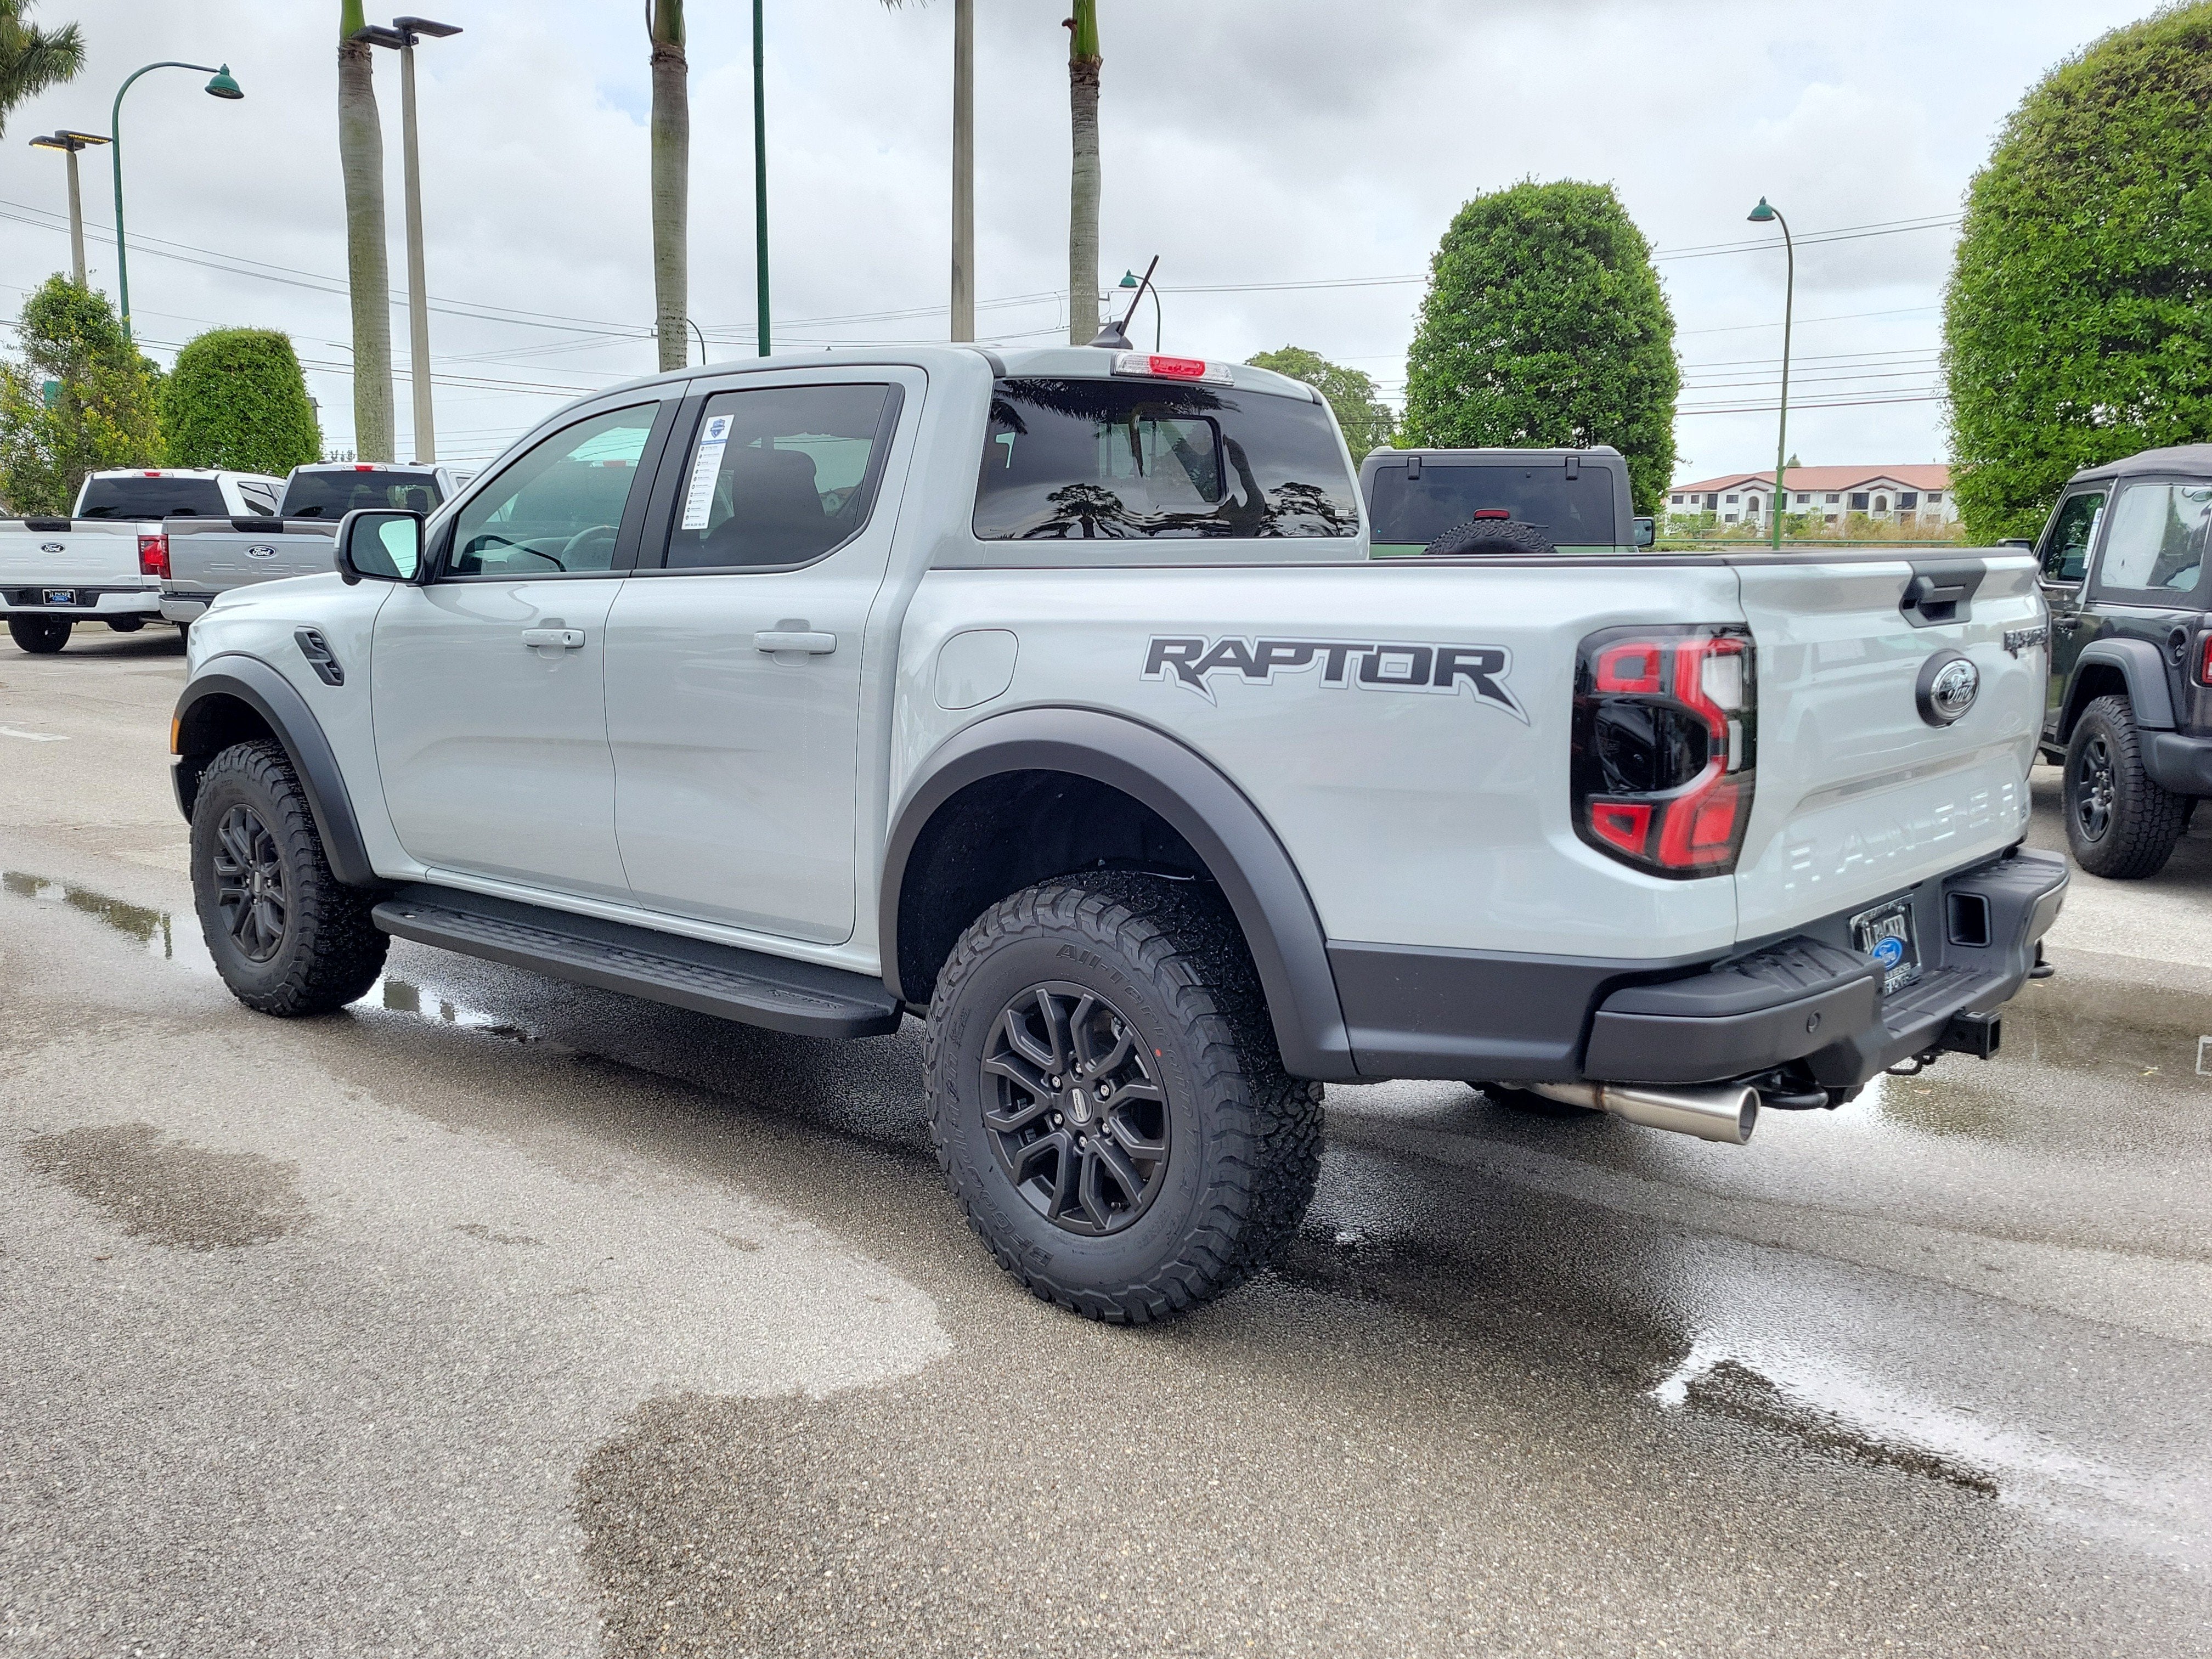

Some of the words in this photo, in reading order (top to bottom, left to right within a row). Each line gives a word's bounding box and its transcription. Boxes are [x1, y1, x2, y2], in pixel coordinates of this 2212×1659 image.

[204, 561, 321, 575] F-150
[251, 547, 272, 557] Ford
[1139, 634, 1531, 726] RAPTOR
[1056, 942, 1195, 1119] All-Terrain
[944, 1052, 1055, 1267] BFGoodrich
